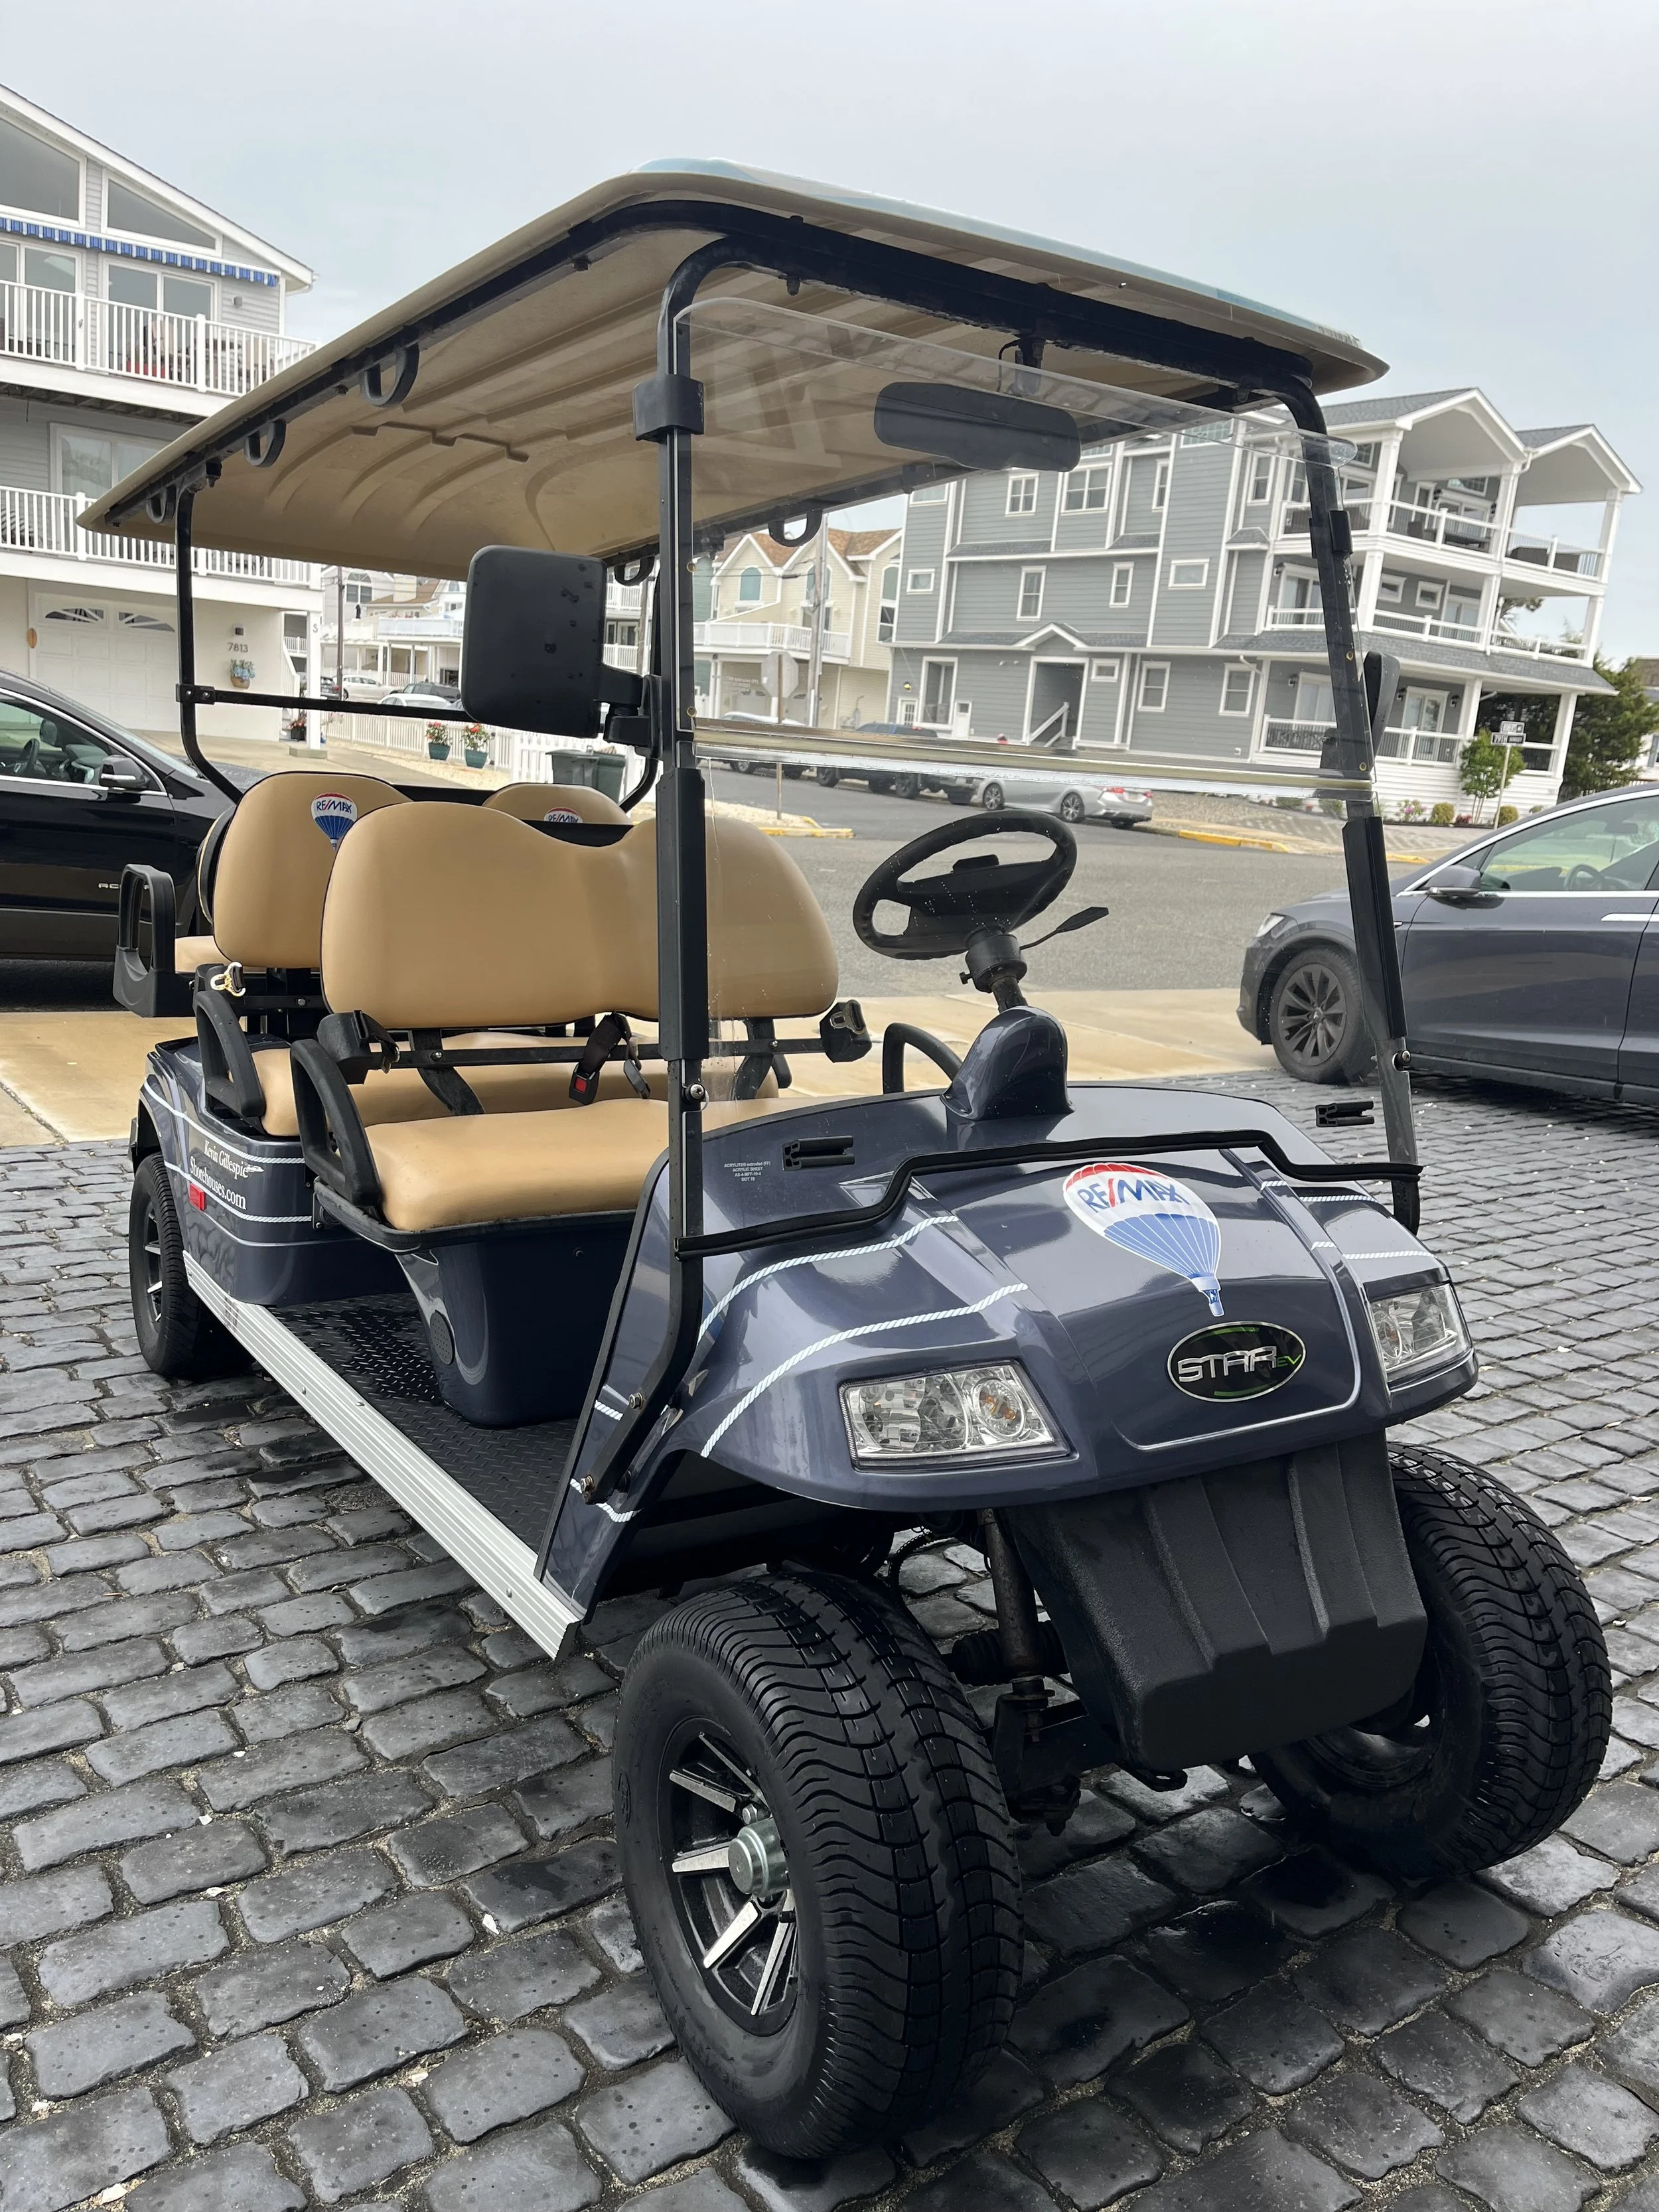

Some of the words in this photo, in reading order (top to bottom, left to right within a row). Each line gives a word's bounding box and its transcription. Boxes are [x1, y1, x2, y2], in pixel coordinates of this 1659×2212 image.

[228, 642, 249, 653] 7813
[316, 799, 352, 814] RE/MAX
[204, 1140, 218, 1163] Kevin
[218, 1150, 249, 1180] Gillespie
[190, 1155, 247, 1210] Shorehouses.com
[1077, 1178, 1190, 1213] RE/MAX
[1177, 1346, 1277, 1382] STAR
[1276, 1354, 1302, 1368] EV
